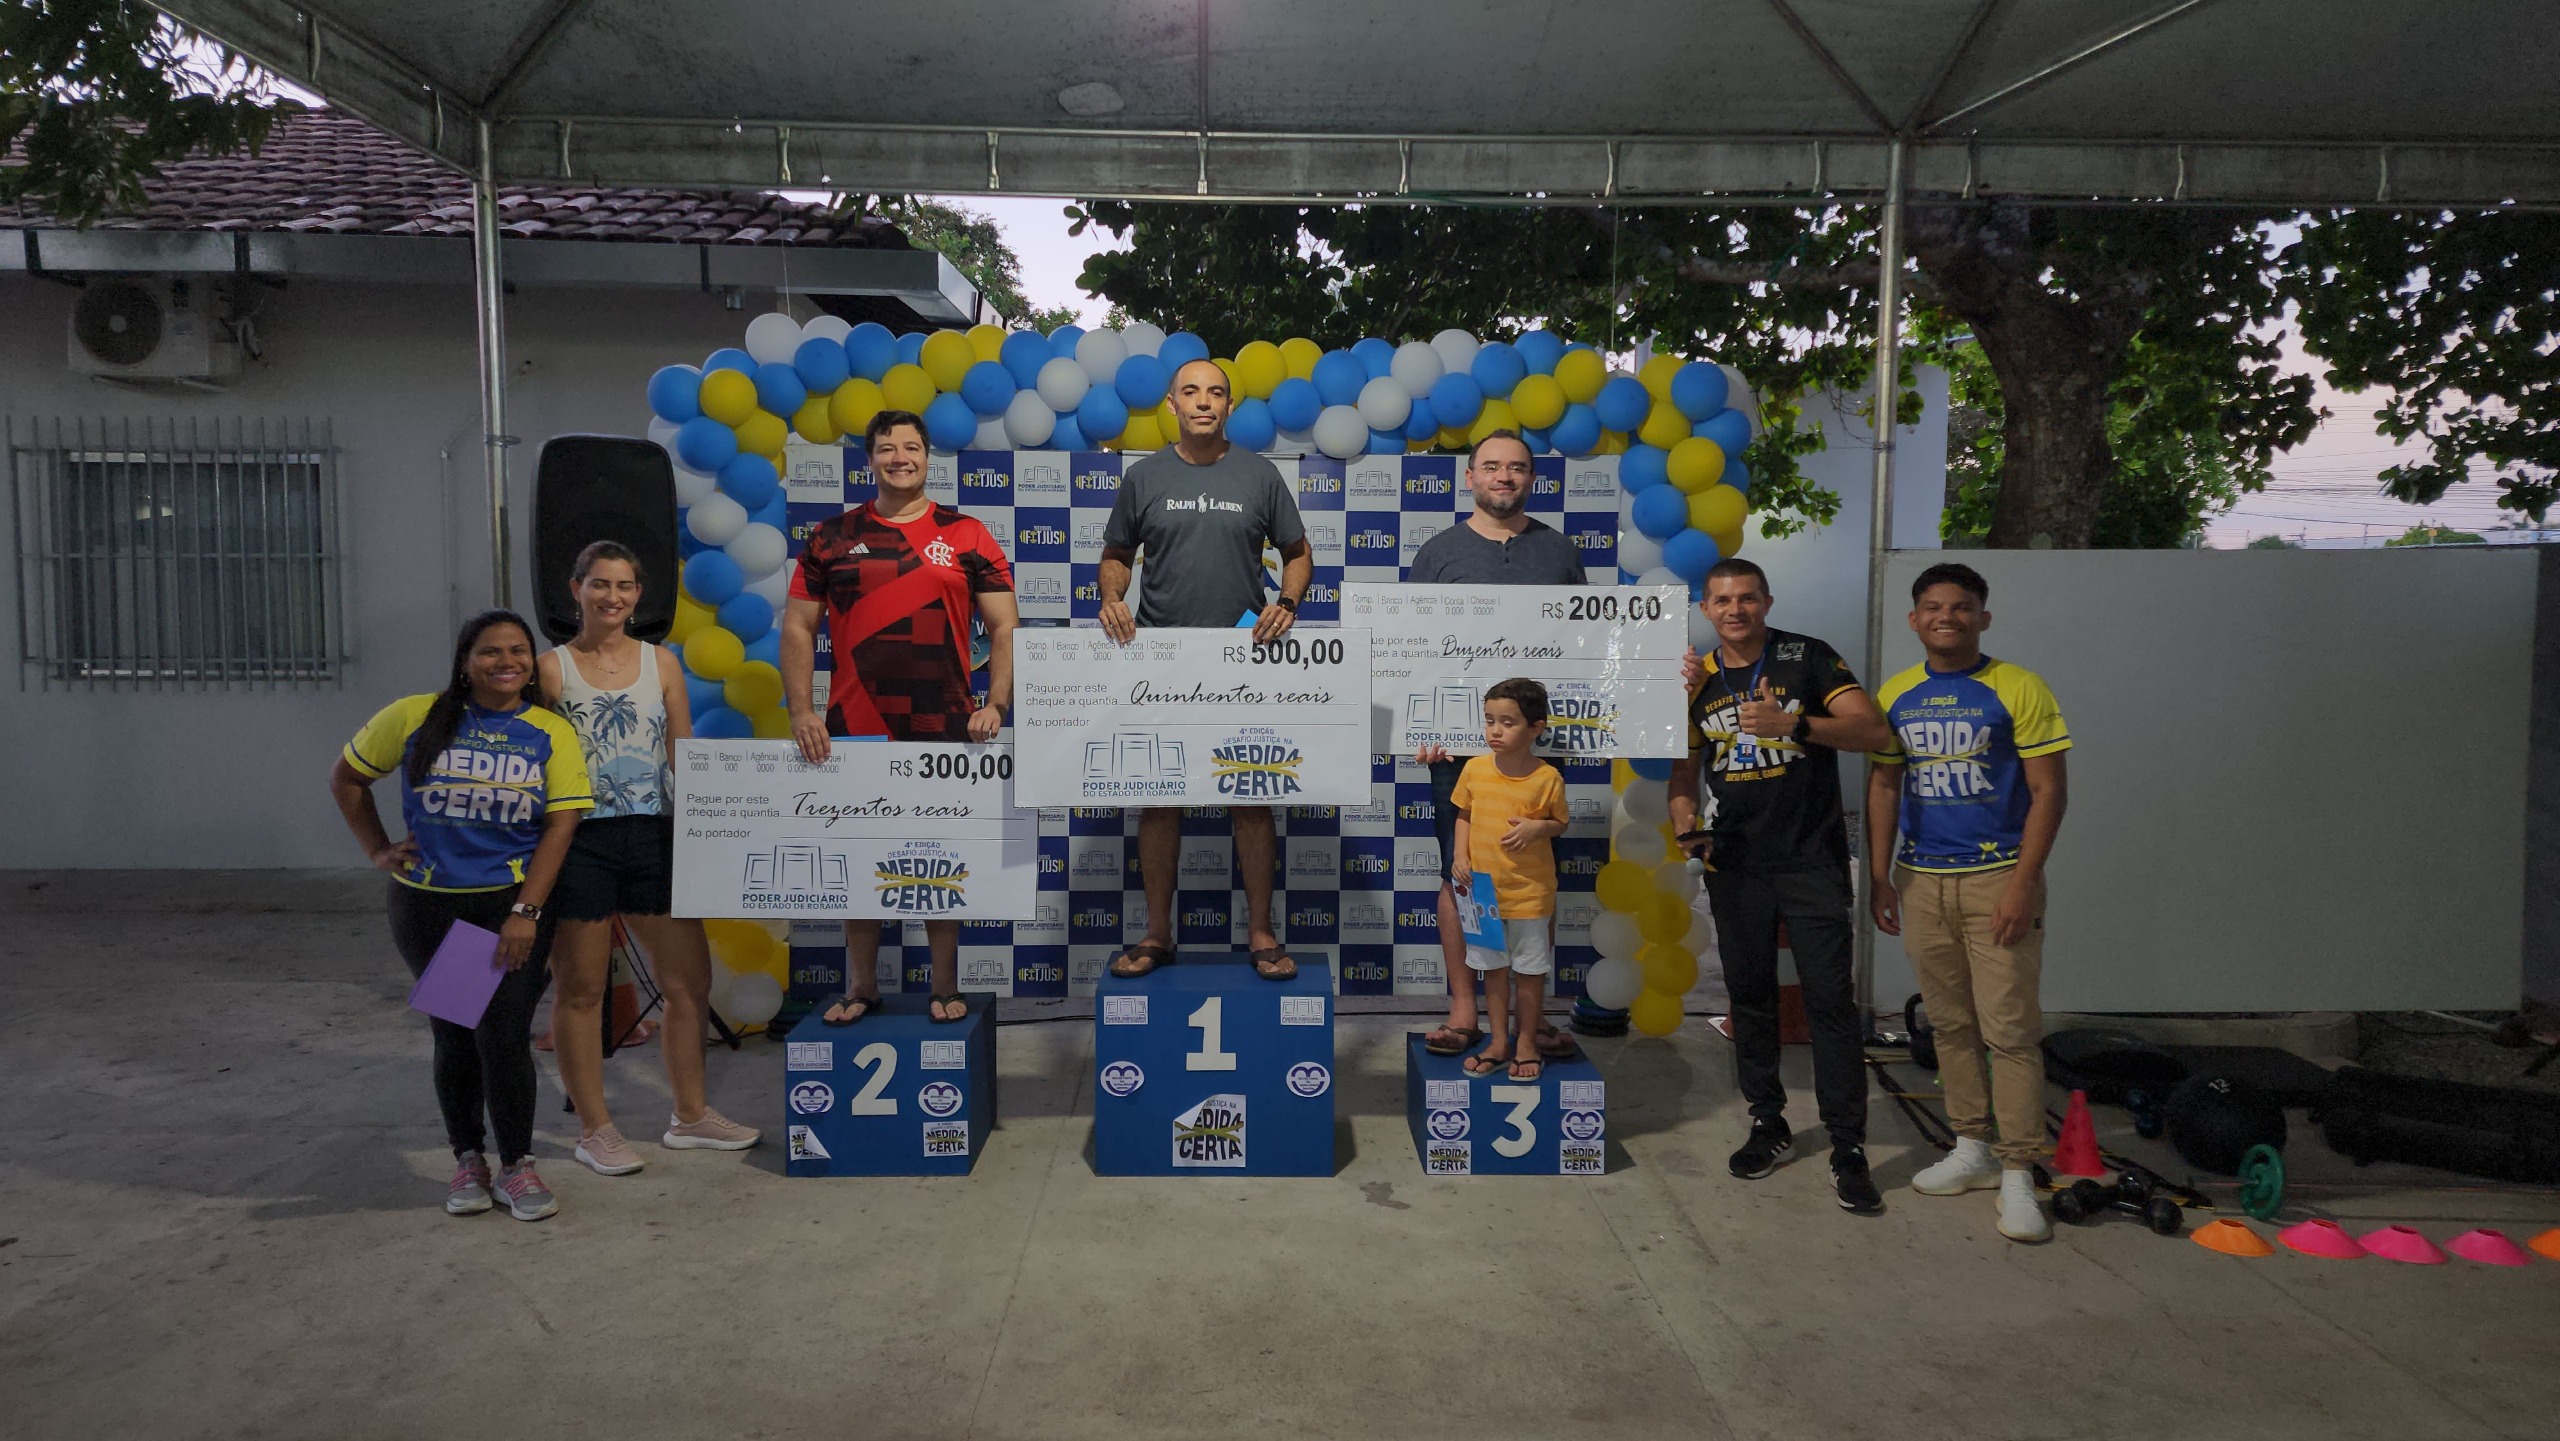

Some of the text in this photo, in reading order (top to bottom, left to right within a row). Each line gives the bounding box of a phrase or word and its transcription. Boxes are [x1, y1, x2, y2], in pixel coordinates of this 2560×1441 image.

[1542, 595, 1661, 626] R$ 200,00
[1150, 640, 1177, 652] Cheque
[1387, 637, 1404, 647] por
[1406, 636, 1429, 646] este
[1028, 651, 1047, 661] 0000
[1153, 651, 1175, 661] 00000
[1223, 638, 1344, 671] R$ 500,00
[1401, 649, 1439, 659] quantia
[1441, 634, 1565, 671] Duzentos reais
[1025, 683, 1107, 695] Pague por este
[1130, 680, 1334, 706] Quinhentos reais
[1025, 697, 1066, 708] cheque
[1078, 697, 1118, 708] quantia
[1704, 696, 1734, 714] DESAFIO
[1027, 717, 1090, 729] Ao portador
[1405, 732, 1486, 742] PODER JUDICIÁ
[1535, 724, 1619, 750] CERTA
[1212, 744, 1300, 768] MEDIDA
[690, 762, 709, 772] 0000
[724, 763, 739, 772] 000
[756, 763, 775, 773] 0000
[889, 752, 1013, 786] R$ 300,00
[1082, 778, 1186, 791] PODER JUDICIÁRIO
[1217, 769, 1303, 796] CERTA
[422, 781, 532, 824] CERTA
[686, 793, 770, 805] Pague por este
[686, 807, 780, 819] cheque a quantia
[792, 791, 974, 829] Trezentos reais
[686, 827, 752, 839] Ao portador
[875, 858, 967, 882] MEDIDA
[742, 890, 849, 904] PODER JUDICIÁRIO
[880, 883, 968, 911] CERTA
[742, 902, 848, 910] DO ESTADO DE RORAIMA
[1185, 996, 1237, 1071] 1
[851, 1042, 898, 1116] 2
[1195, 1109, 1242, 1132] EDIDA
[1490, 1085, 1541, 1158] 3
[928, 1141, 967, 1153] CERTA
[1179, 1134, 1244, 1161] CERTA
[1431, 1159, 1469, 1171] CERTA
[1564, 1159, 1601, 1171] CERTA
